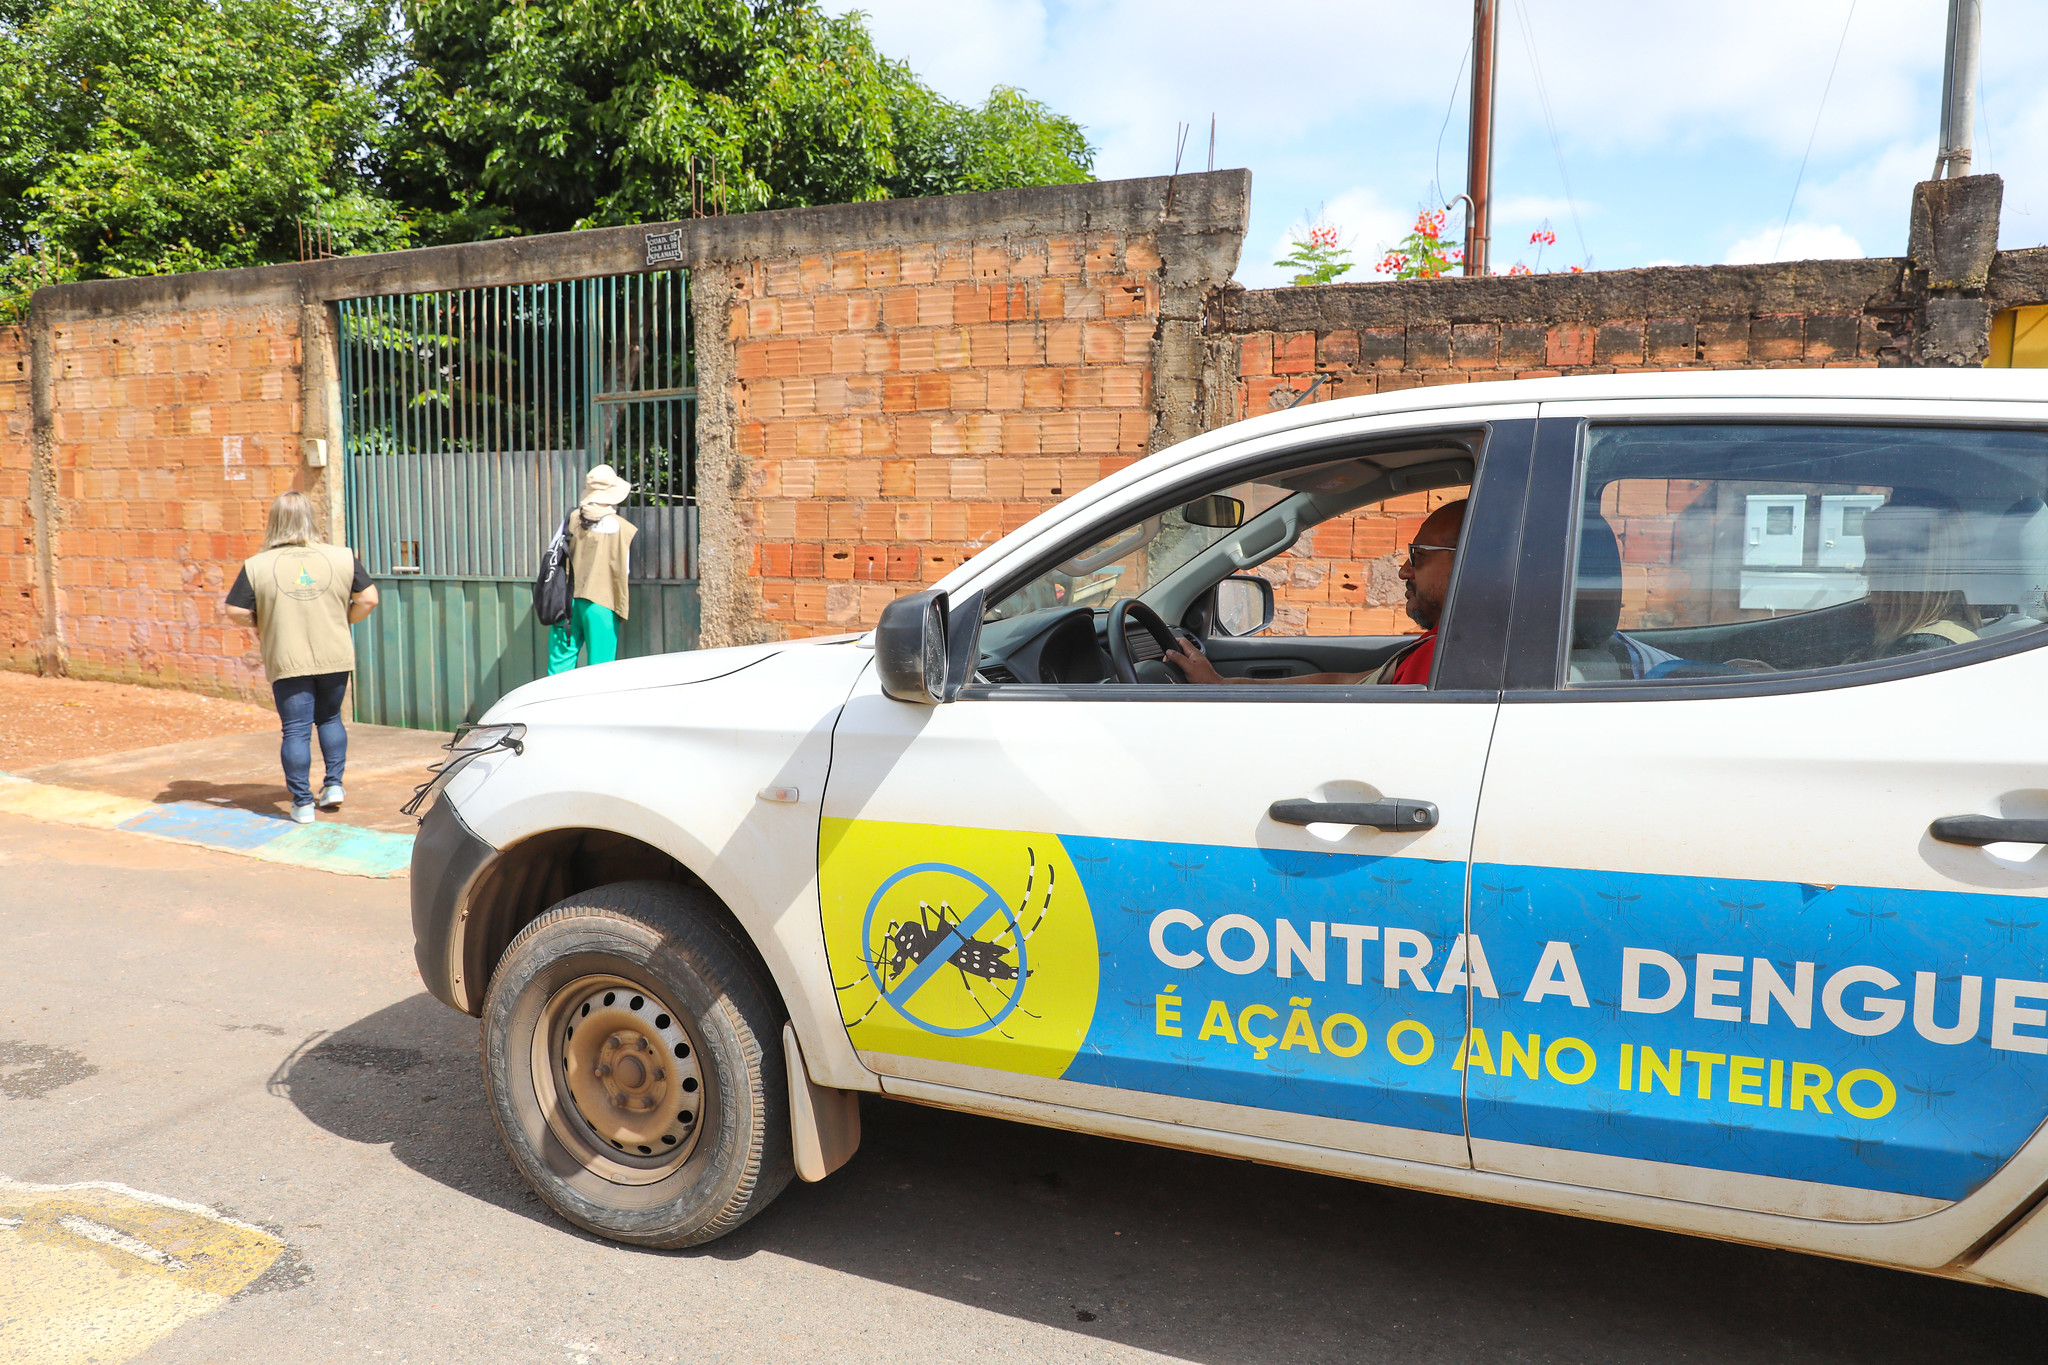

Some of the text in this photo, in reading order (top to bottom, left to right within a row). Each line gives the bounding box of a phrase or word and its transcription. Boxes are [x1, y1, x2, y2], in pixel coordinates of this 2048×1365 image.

[1149, 909, 2048, 1055] CONTRA A DENGUE
[1155, 984, 1897, 1120] É AÇÃO O ANO INTEIRO
